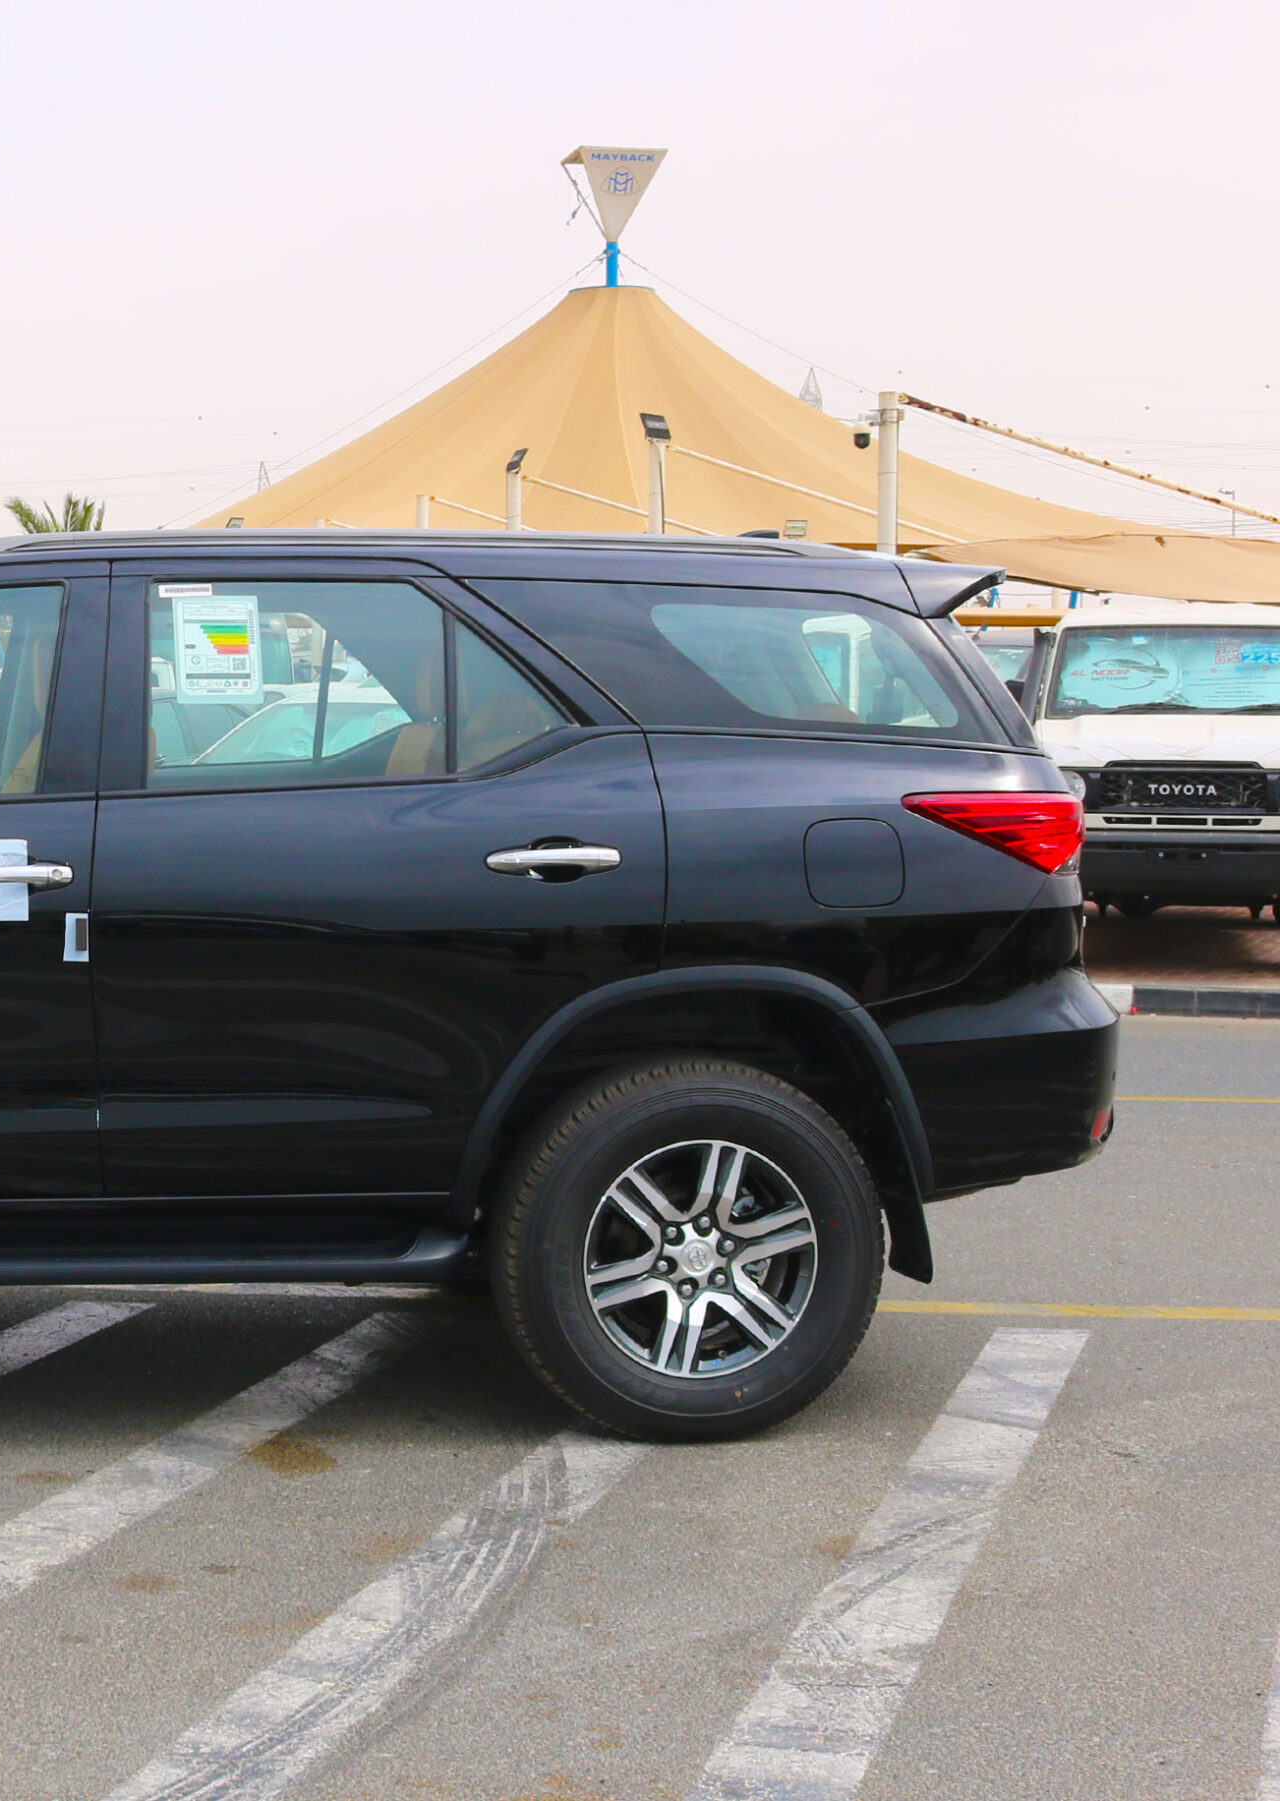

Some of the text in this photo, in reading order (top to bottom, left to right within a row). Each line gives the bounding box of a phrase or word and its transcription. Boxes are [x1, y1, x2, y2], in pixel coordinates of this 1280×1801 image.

[591, 152, 655, 162] MAYBACK
[1091, 668, 1130, 676] NOOR
[1147, 783, 1217, 796] TOYOTA
